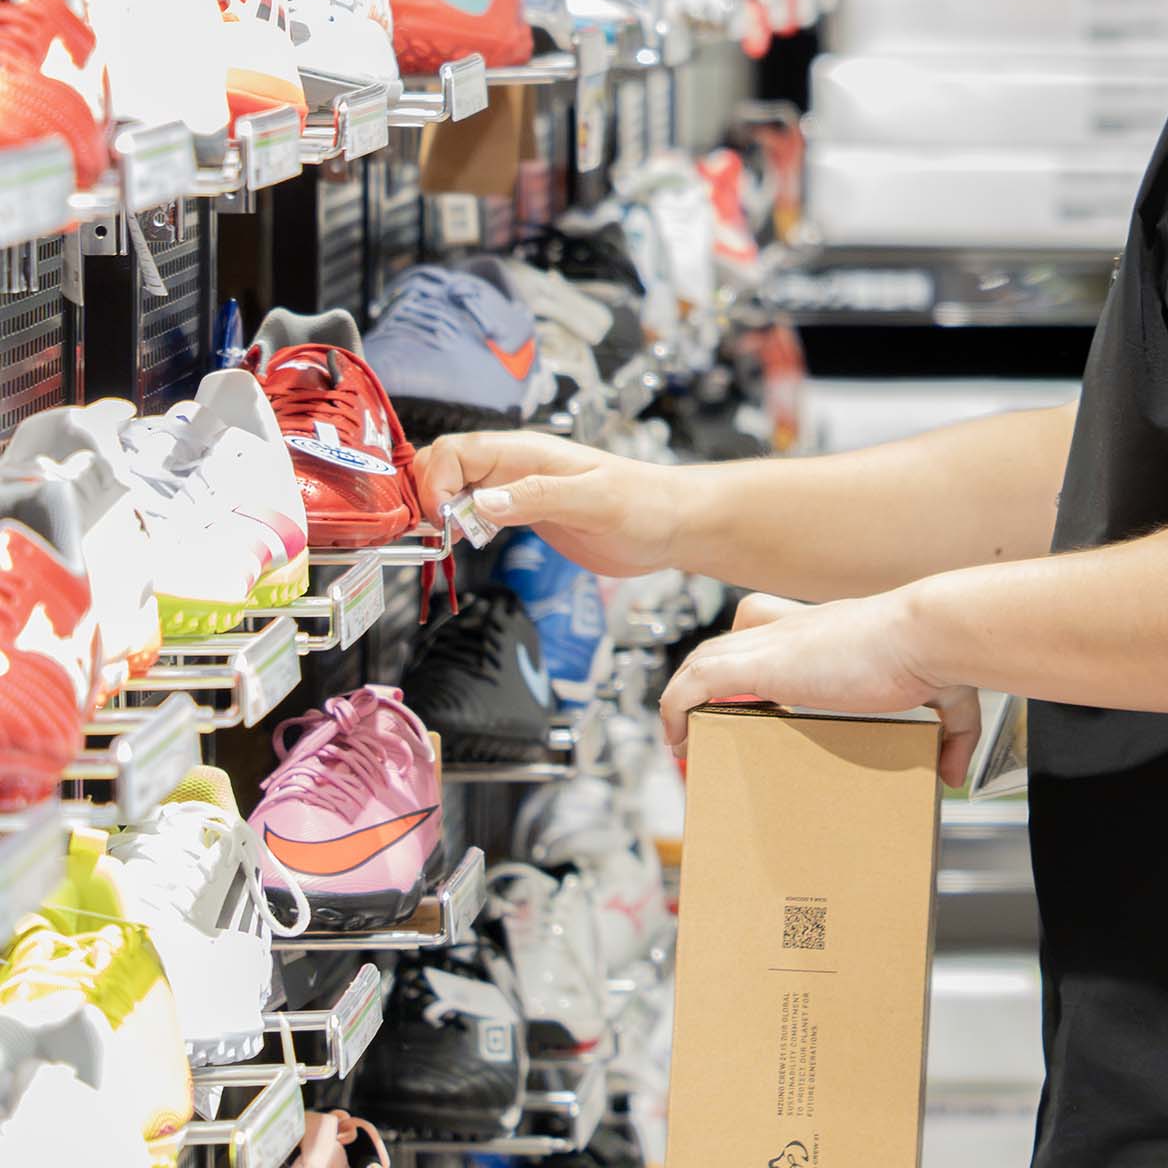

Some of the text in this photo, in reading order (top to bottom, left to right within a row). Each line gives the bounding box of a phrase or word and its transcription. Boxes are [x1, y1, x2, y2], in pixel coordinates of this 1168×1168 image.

[781, 992, 789, 1023] GLOBAL
[780, 1025, 788, 1041] OUR
[801, 1012, 809, 1043] PLANET
[779, 1053, 786, 1061] 21
[780, 1043, 787, 1051] IS
[787, 992, 799, 1116] SUSTAINABILITY COMMITMENT
[799, 1047, 807, 1064] OUR
[797, 1067, 806, 1103] PROTECT
[777, 1086, 785, 1116] MIZUNO
[797, 1106, 804, 1116] TO
[807, 1086, 815, 1117] FUTURE
